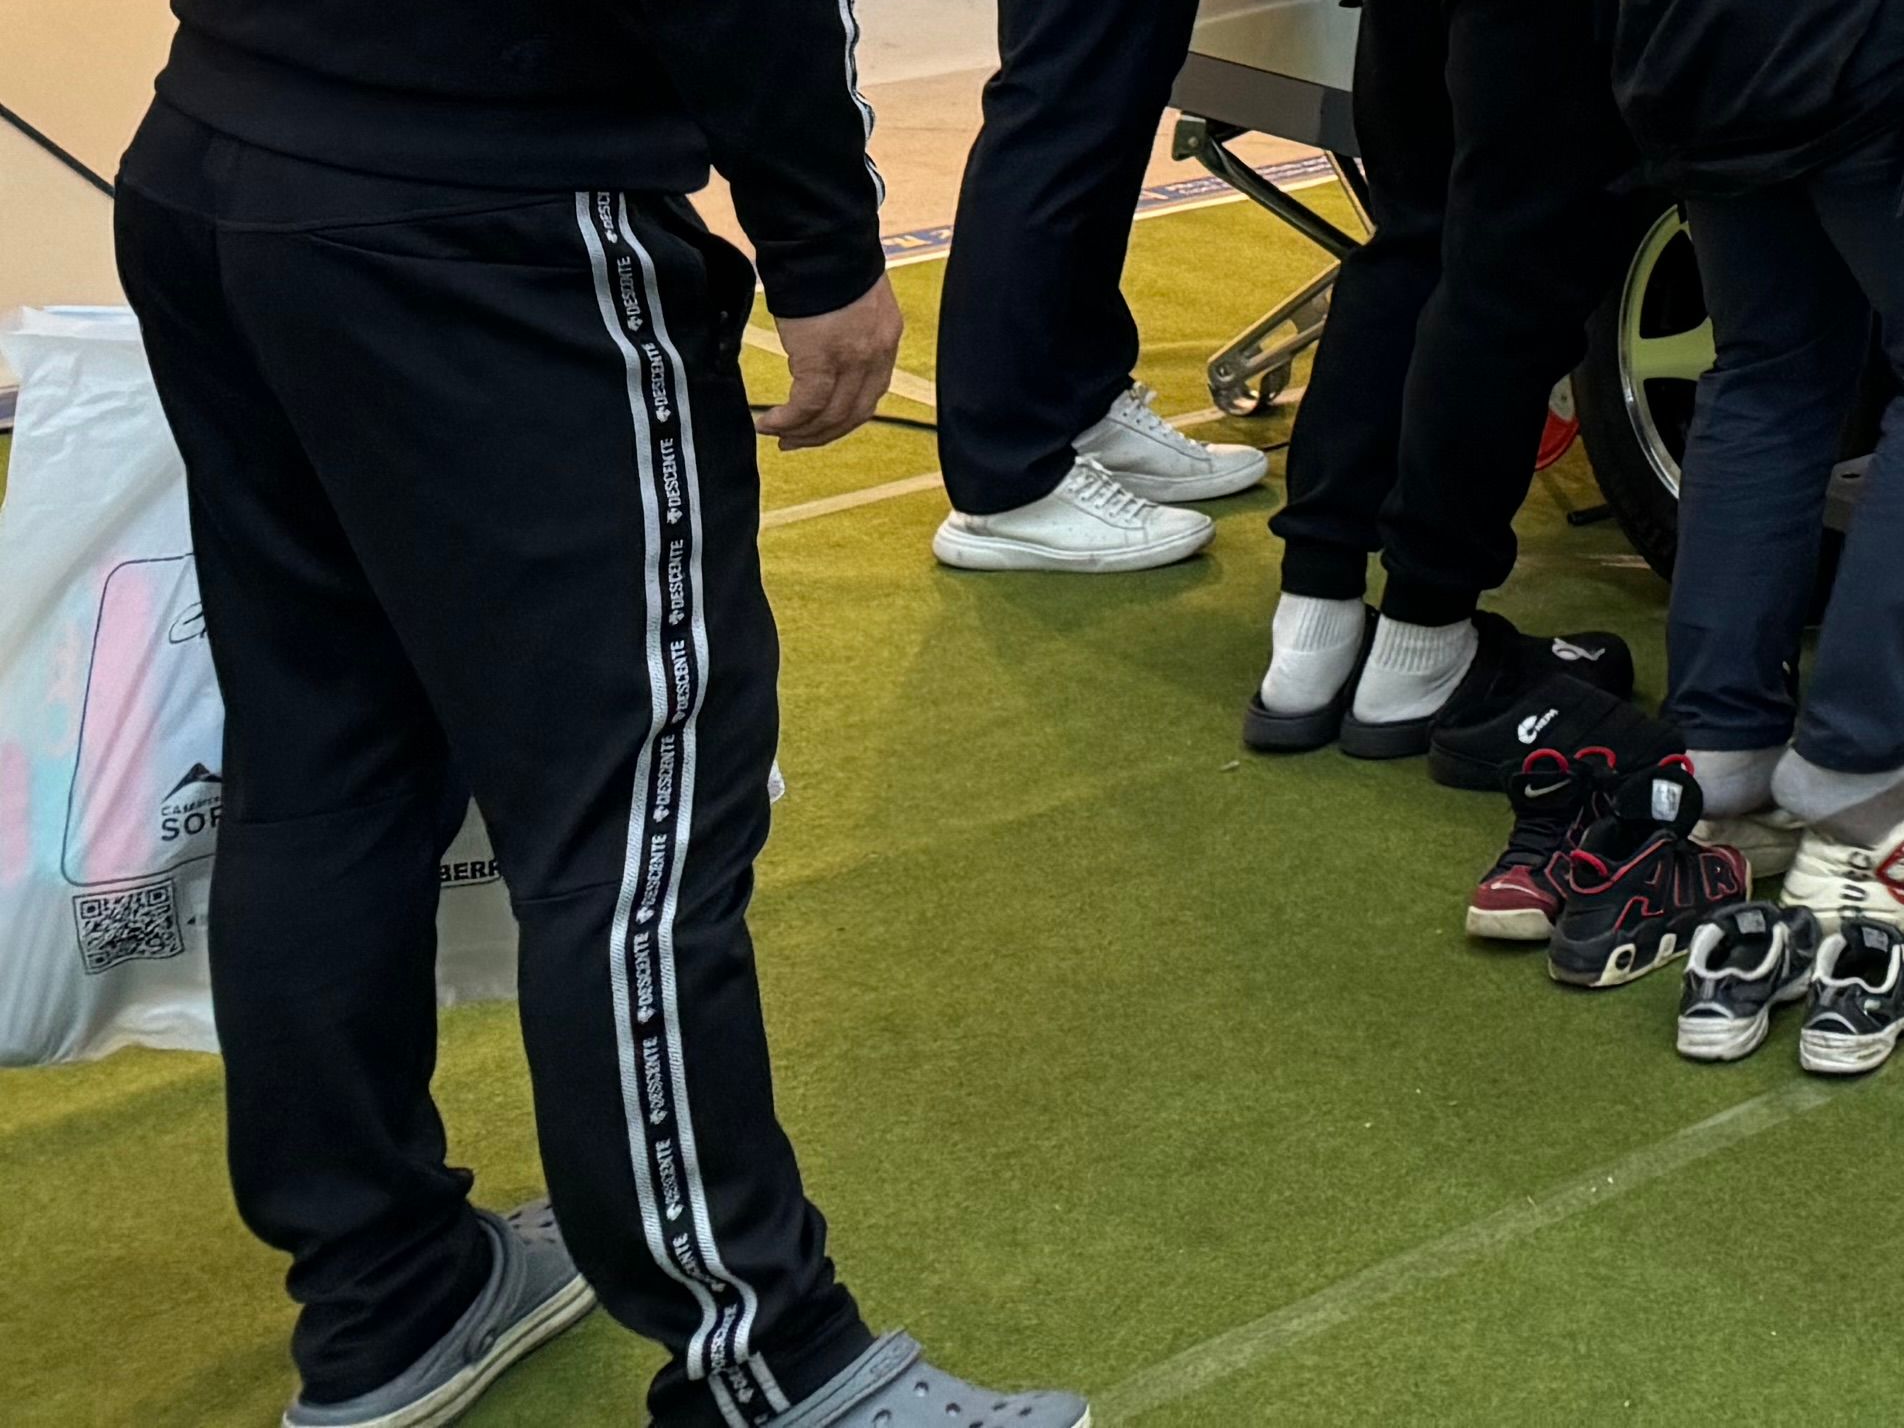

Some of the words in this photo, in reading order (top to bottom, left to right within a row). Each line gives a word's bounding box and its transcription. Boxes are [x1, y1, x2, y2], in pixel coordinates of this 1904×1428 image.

[660, 438, 682, 508] DESCENTE
[668, 539, 685, 609] DESCENTE
[670, 640, 690, 712] DESCENTE
[656, 733, 676, 806] DESCENTE
